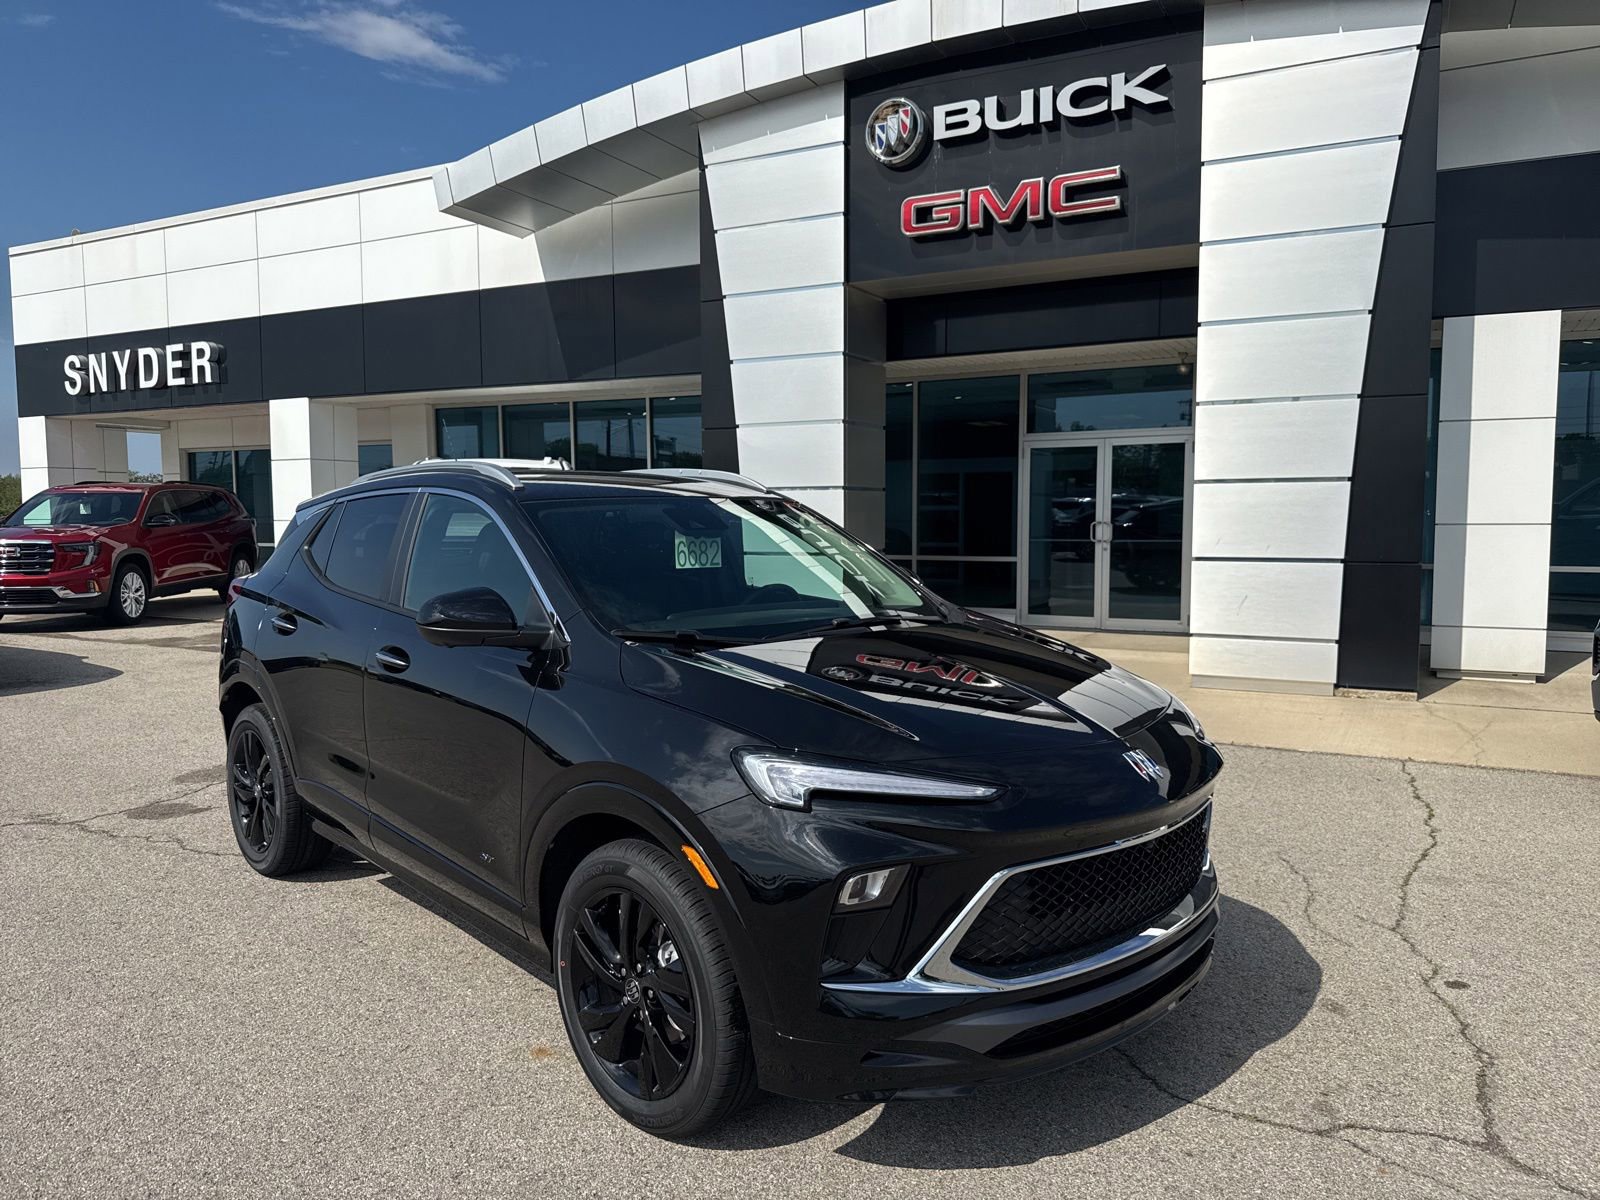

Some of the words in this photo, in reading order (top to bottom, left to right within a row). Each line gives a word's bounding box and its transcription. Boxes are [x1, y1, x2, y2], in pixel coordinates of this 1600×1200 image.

[933, 64, 1169, 141] BUICK
[901, 165, 1121, 237] GMC
[63, 341, 215, 396] SNYDER
[676, 540, 721, 568] 6682
